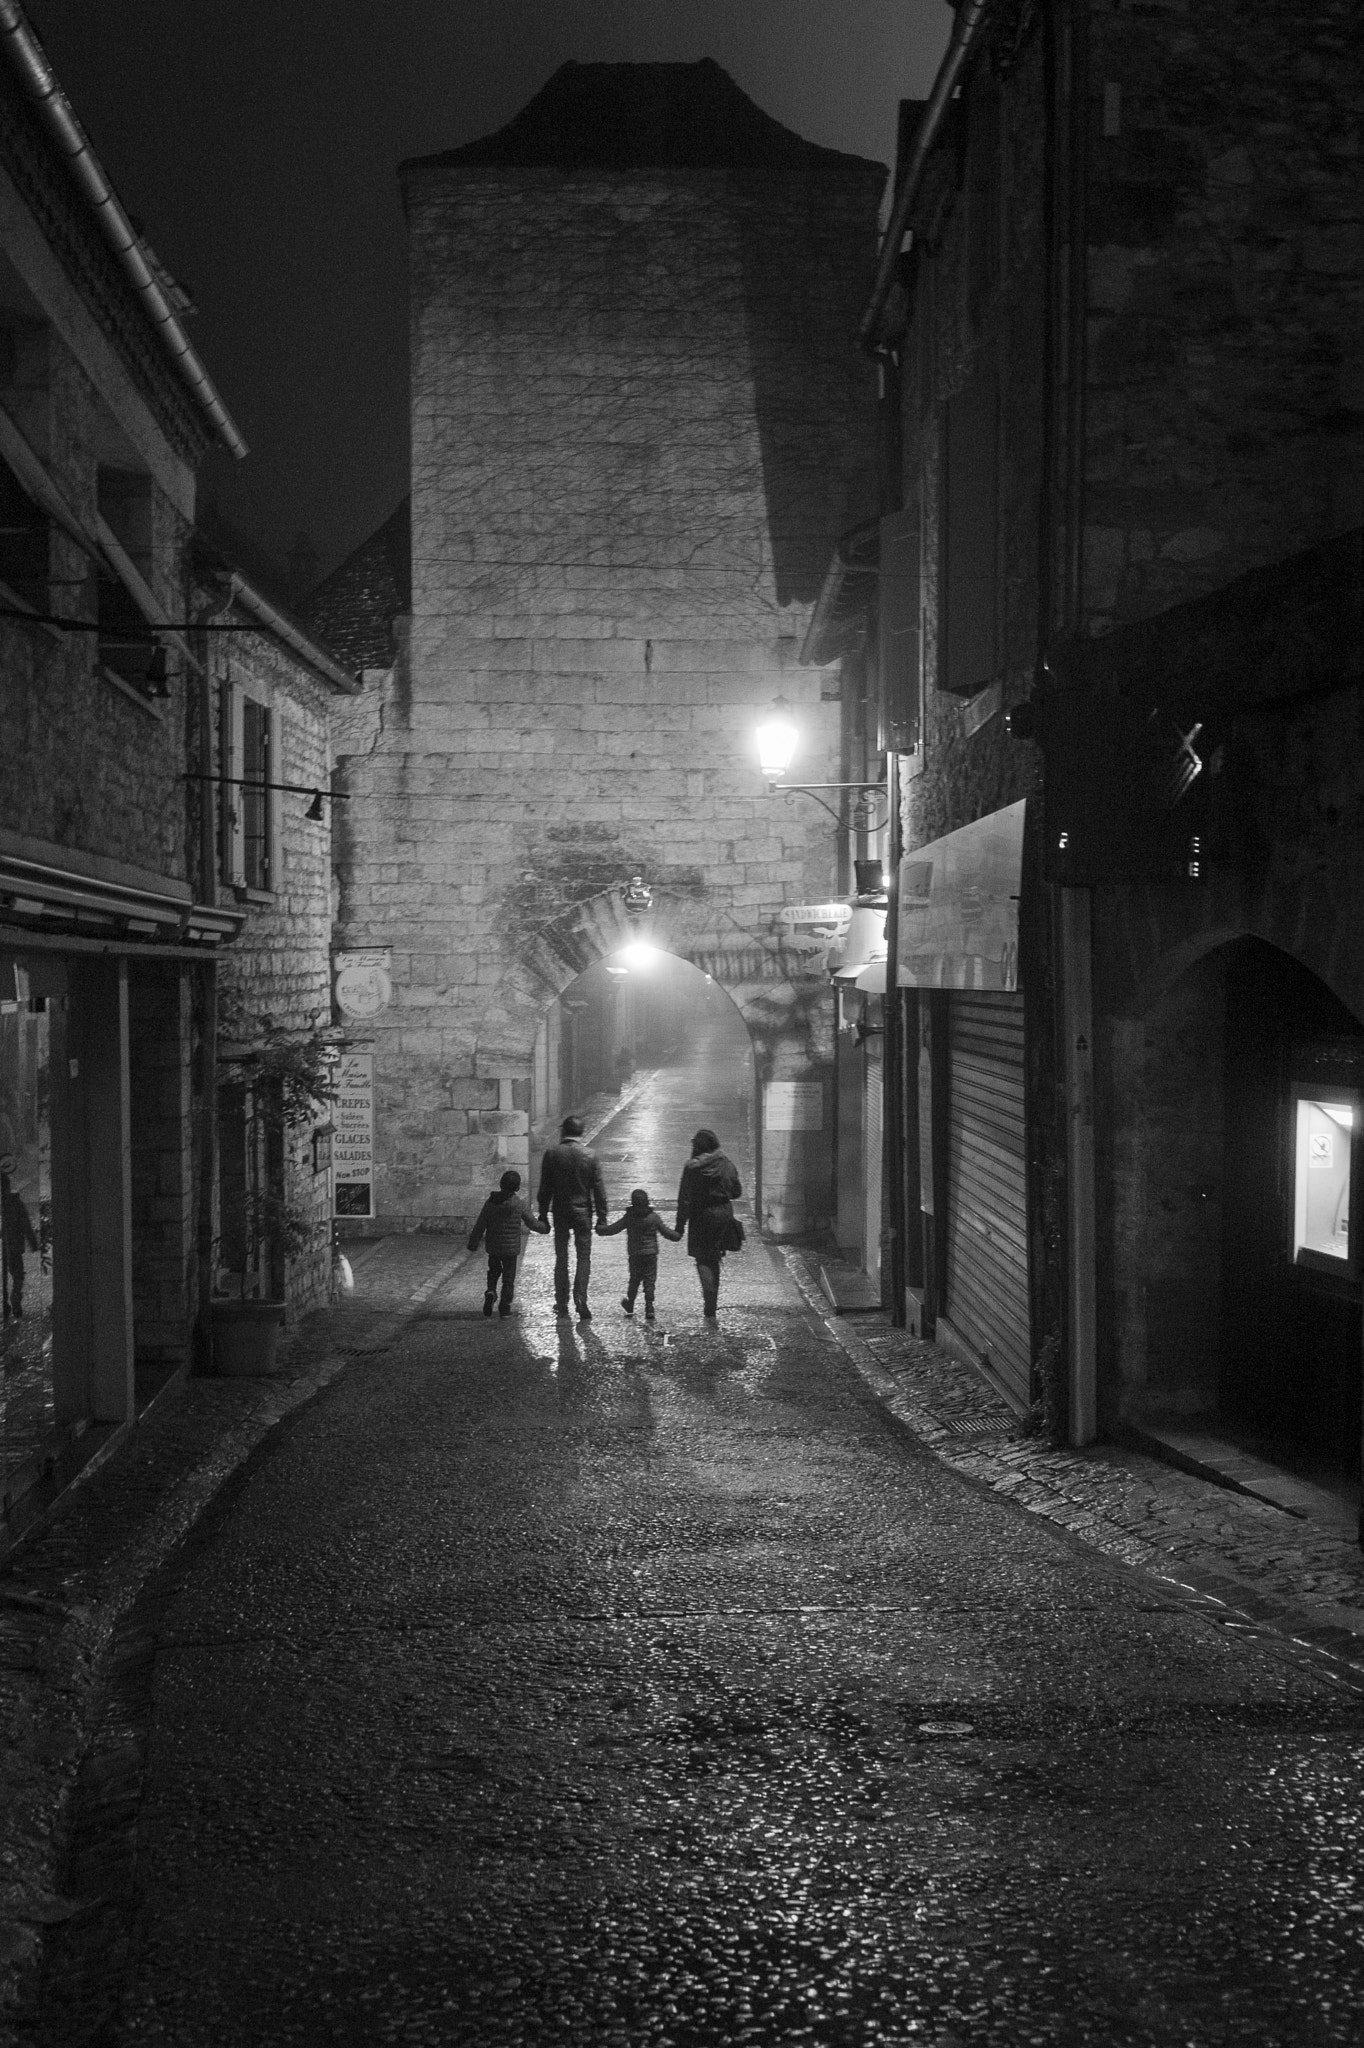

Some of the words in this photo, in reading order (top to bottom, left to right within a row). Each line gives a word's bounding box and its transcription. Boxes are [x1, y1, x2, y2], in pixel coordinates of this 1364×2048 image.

[344, 1058, 359, 1068] La
[341, 1068, 368, 1078] Maison
[345, 1079, 371, 1089] Famille
[334, 1134, 371, 1144] GLACES
[334, 1150, 371, 1160] SALADES
[352, 1167, 370, 1177] STOP
